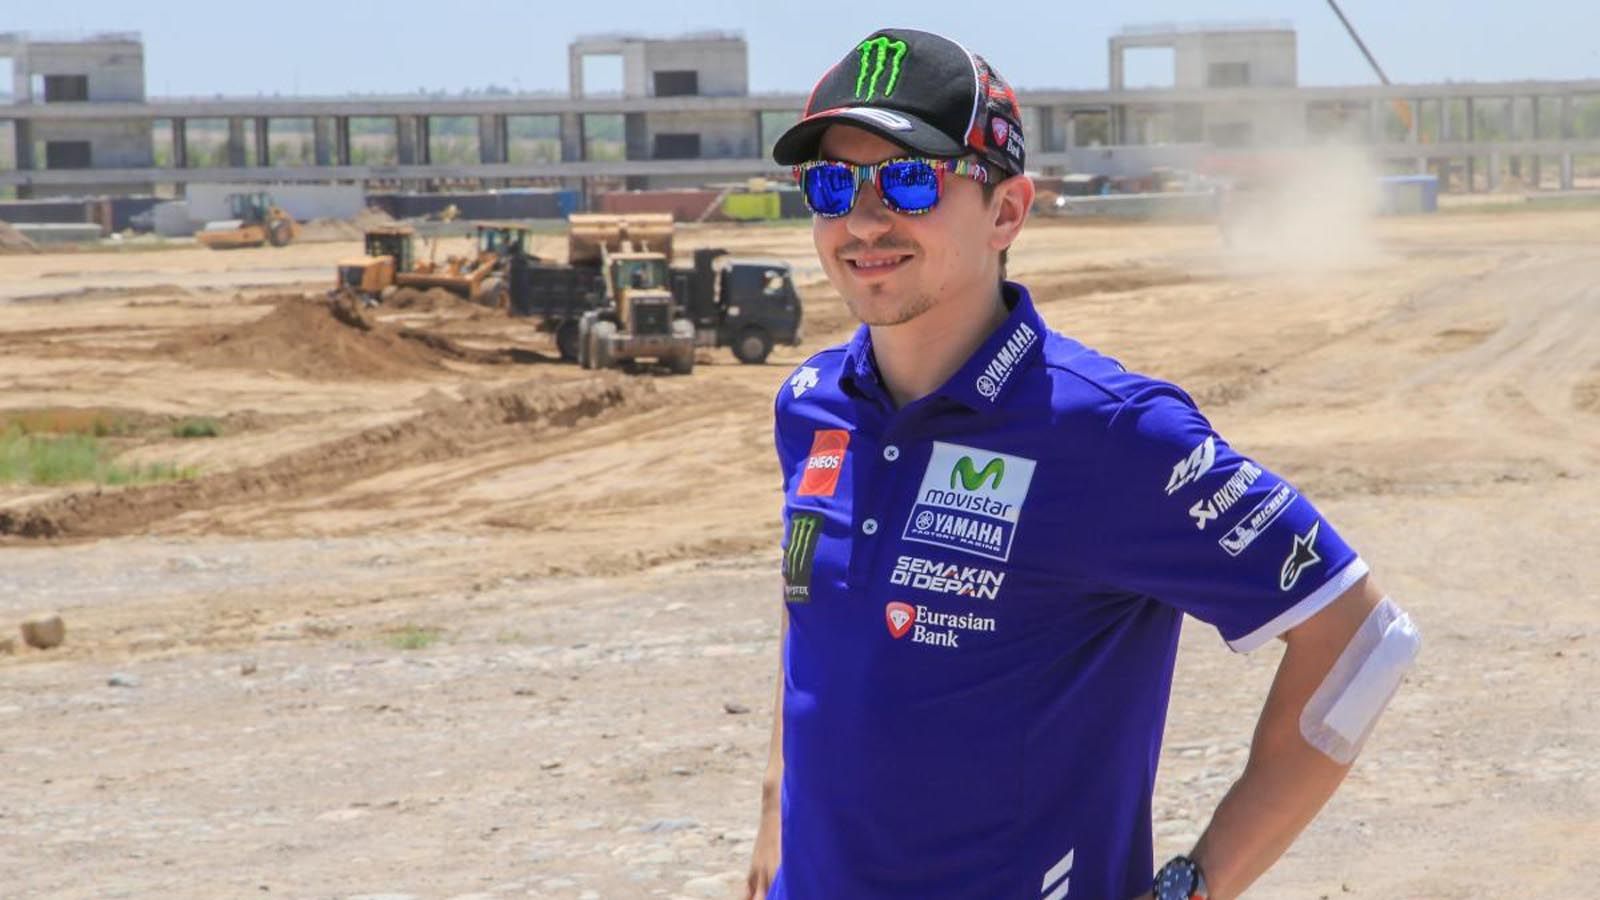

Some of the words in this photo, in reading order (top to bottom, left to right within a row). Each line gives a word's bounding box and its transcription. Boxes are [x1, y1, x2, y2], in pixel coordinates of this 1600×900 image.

[985, 322, 1040, 382] YAMAHA
[807, 454, 840, 469] ENEOS
[1213, 460, 1262, 513] AKRAPO
[924, 488, 1013, 517] movistar
[935, 512, 1003, 547] YAMAHA
[912, 574, 1000, 601] DEPAN
[916, 604, 996, 632] Eurasian
[912, 625, 960, 648] Bank
